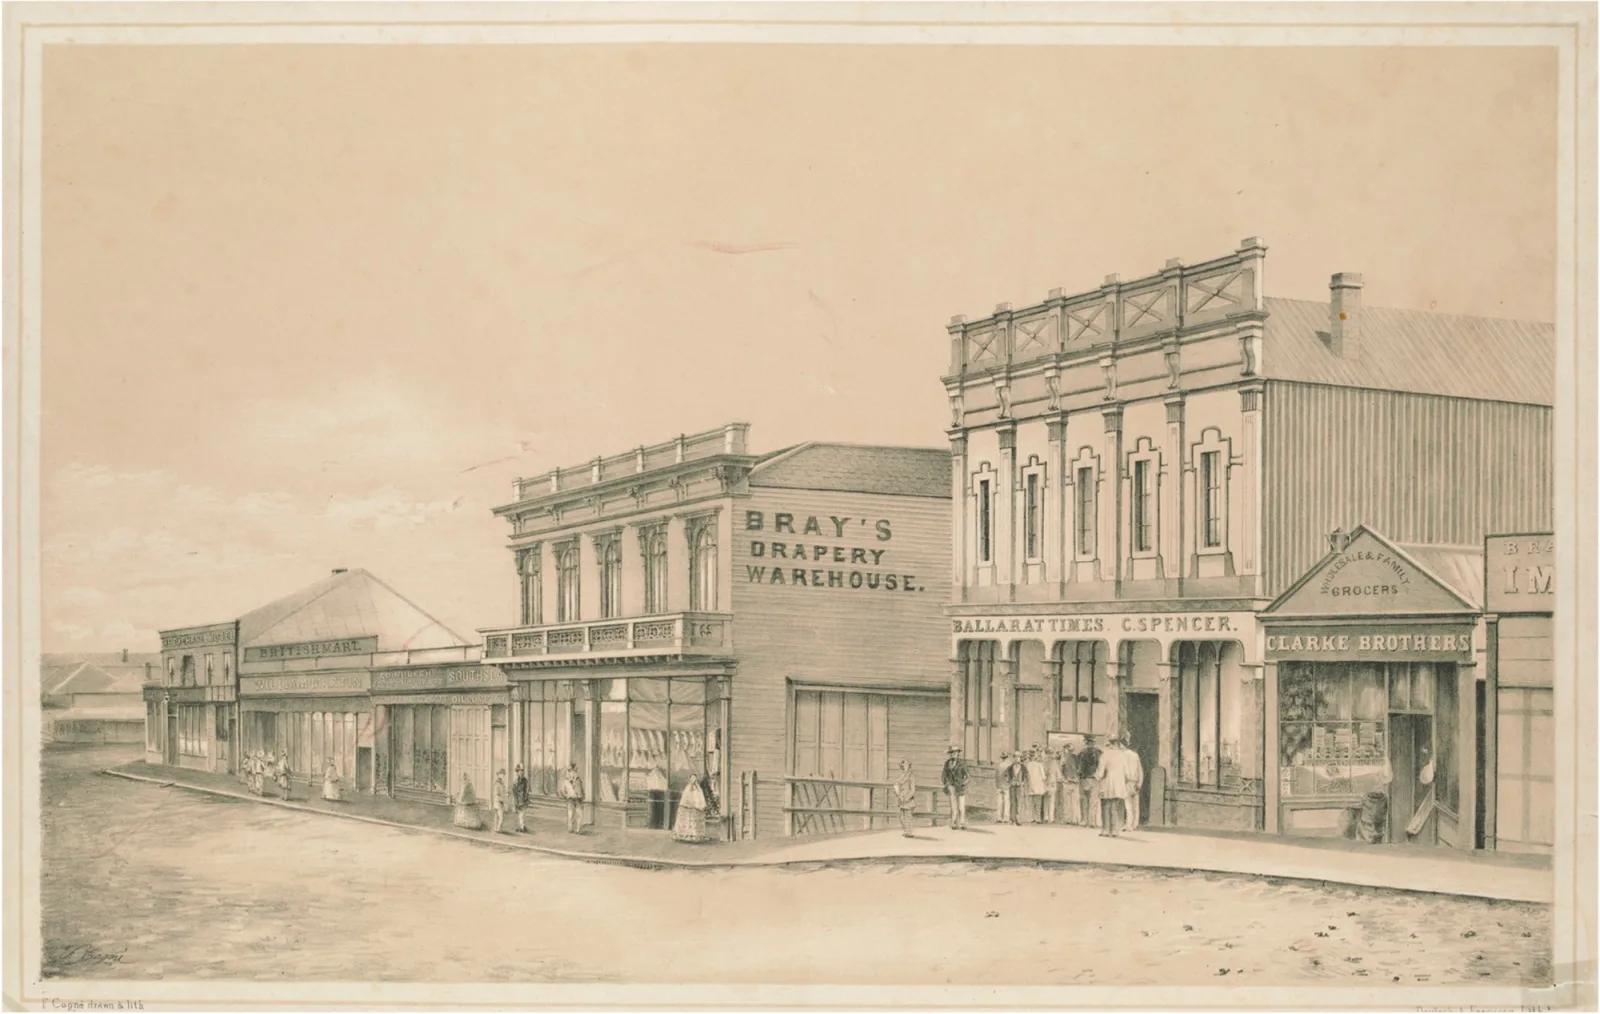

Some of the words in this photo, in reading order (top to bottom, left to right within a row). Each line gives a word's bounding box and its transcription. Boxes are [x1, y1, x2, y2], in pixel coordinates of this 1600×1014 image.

[745, 510, 892, 542] BRAY'S
[750, 540, 886, 565] DRAPERY
[745, 564, 926, 592] WAREHOUSE.
[1320, 551, 1365, 594] WHOLESALE
[1376, 552, 1411, 585] FAMILY
[1331, 584, 1399, 597] GROCERS
[952, 618, 1045, 634] BALLARAT
[1265, 634, 1350, 651] CLARKE
[1358, 633, 1472, 651] BROTHERS
[87, 999, 114, 1009] drawn
